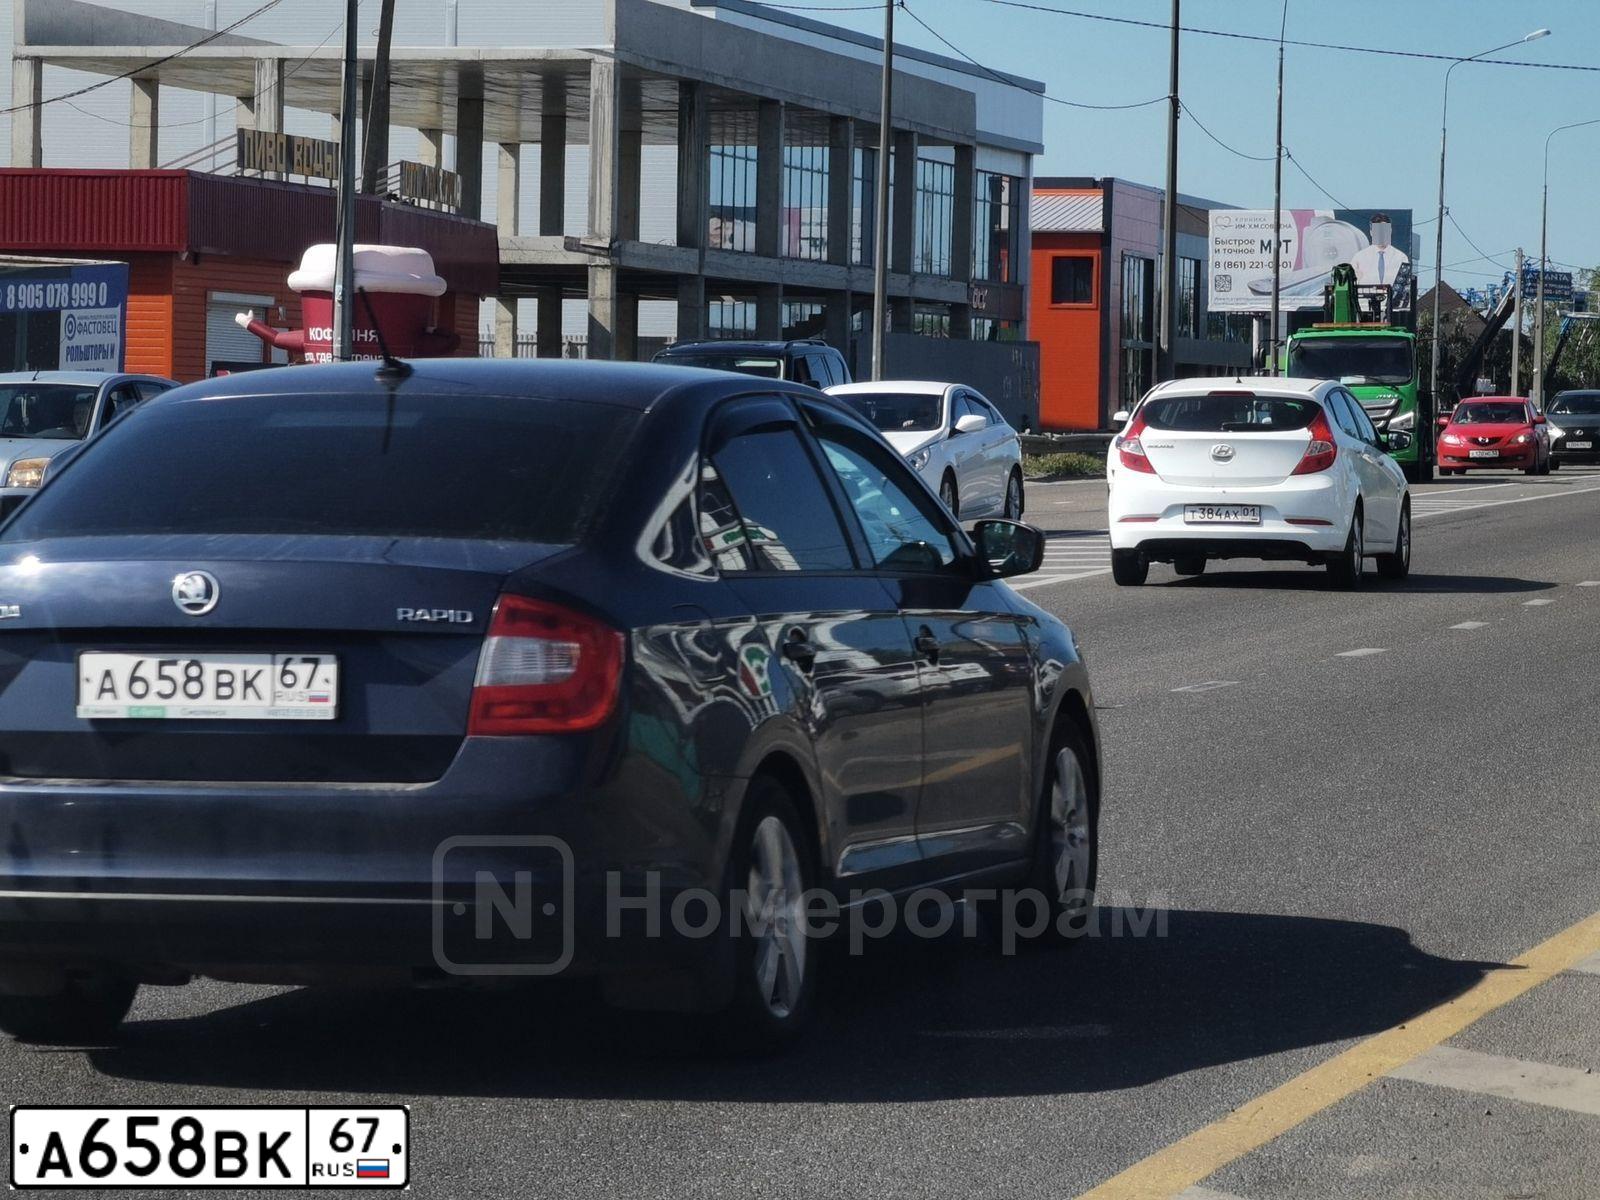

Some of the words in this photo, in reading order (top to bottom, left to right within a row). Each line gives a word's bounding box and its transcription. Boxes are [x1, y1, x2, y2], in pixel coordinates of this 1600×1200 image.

[244, 130, 287, 173] ПИВО
[1214, 237, 1256, 246] Быстрое
[1260, 239, 1292, 254] МТ
[1214, 261, 1221, 269] 8
[1223, 260, 1247, 270] (861)
[1249, 261, 1292, 269] 221-0-01
[6, 284, 15, 309] 8
[18, 283, 43, 309] 905
[46, 282, 69, 308] 078
[71, 282, 97, 307] 999
[99, 281, 107, 306] 0
[77, 319, 117, 336] ФАСТОВЕЦ
[66, 344, 108, 363] РОЛЬШТОРЫ
[109, 343, 115, 360] И
[1189, 507, 1239, 520] Т384АХ
[1242, 507, 1257, 517] 01
[396, 607, 473, 623] RAPID
[97, 659, 264, 700] А658ВК
[280, 657, 321, 689] 67
[274, 691, 308, 702] RUS
